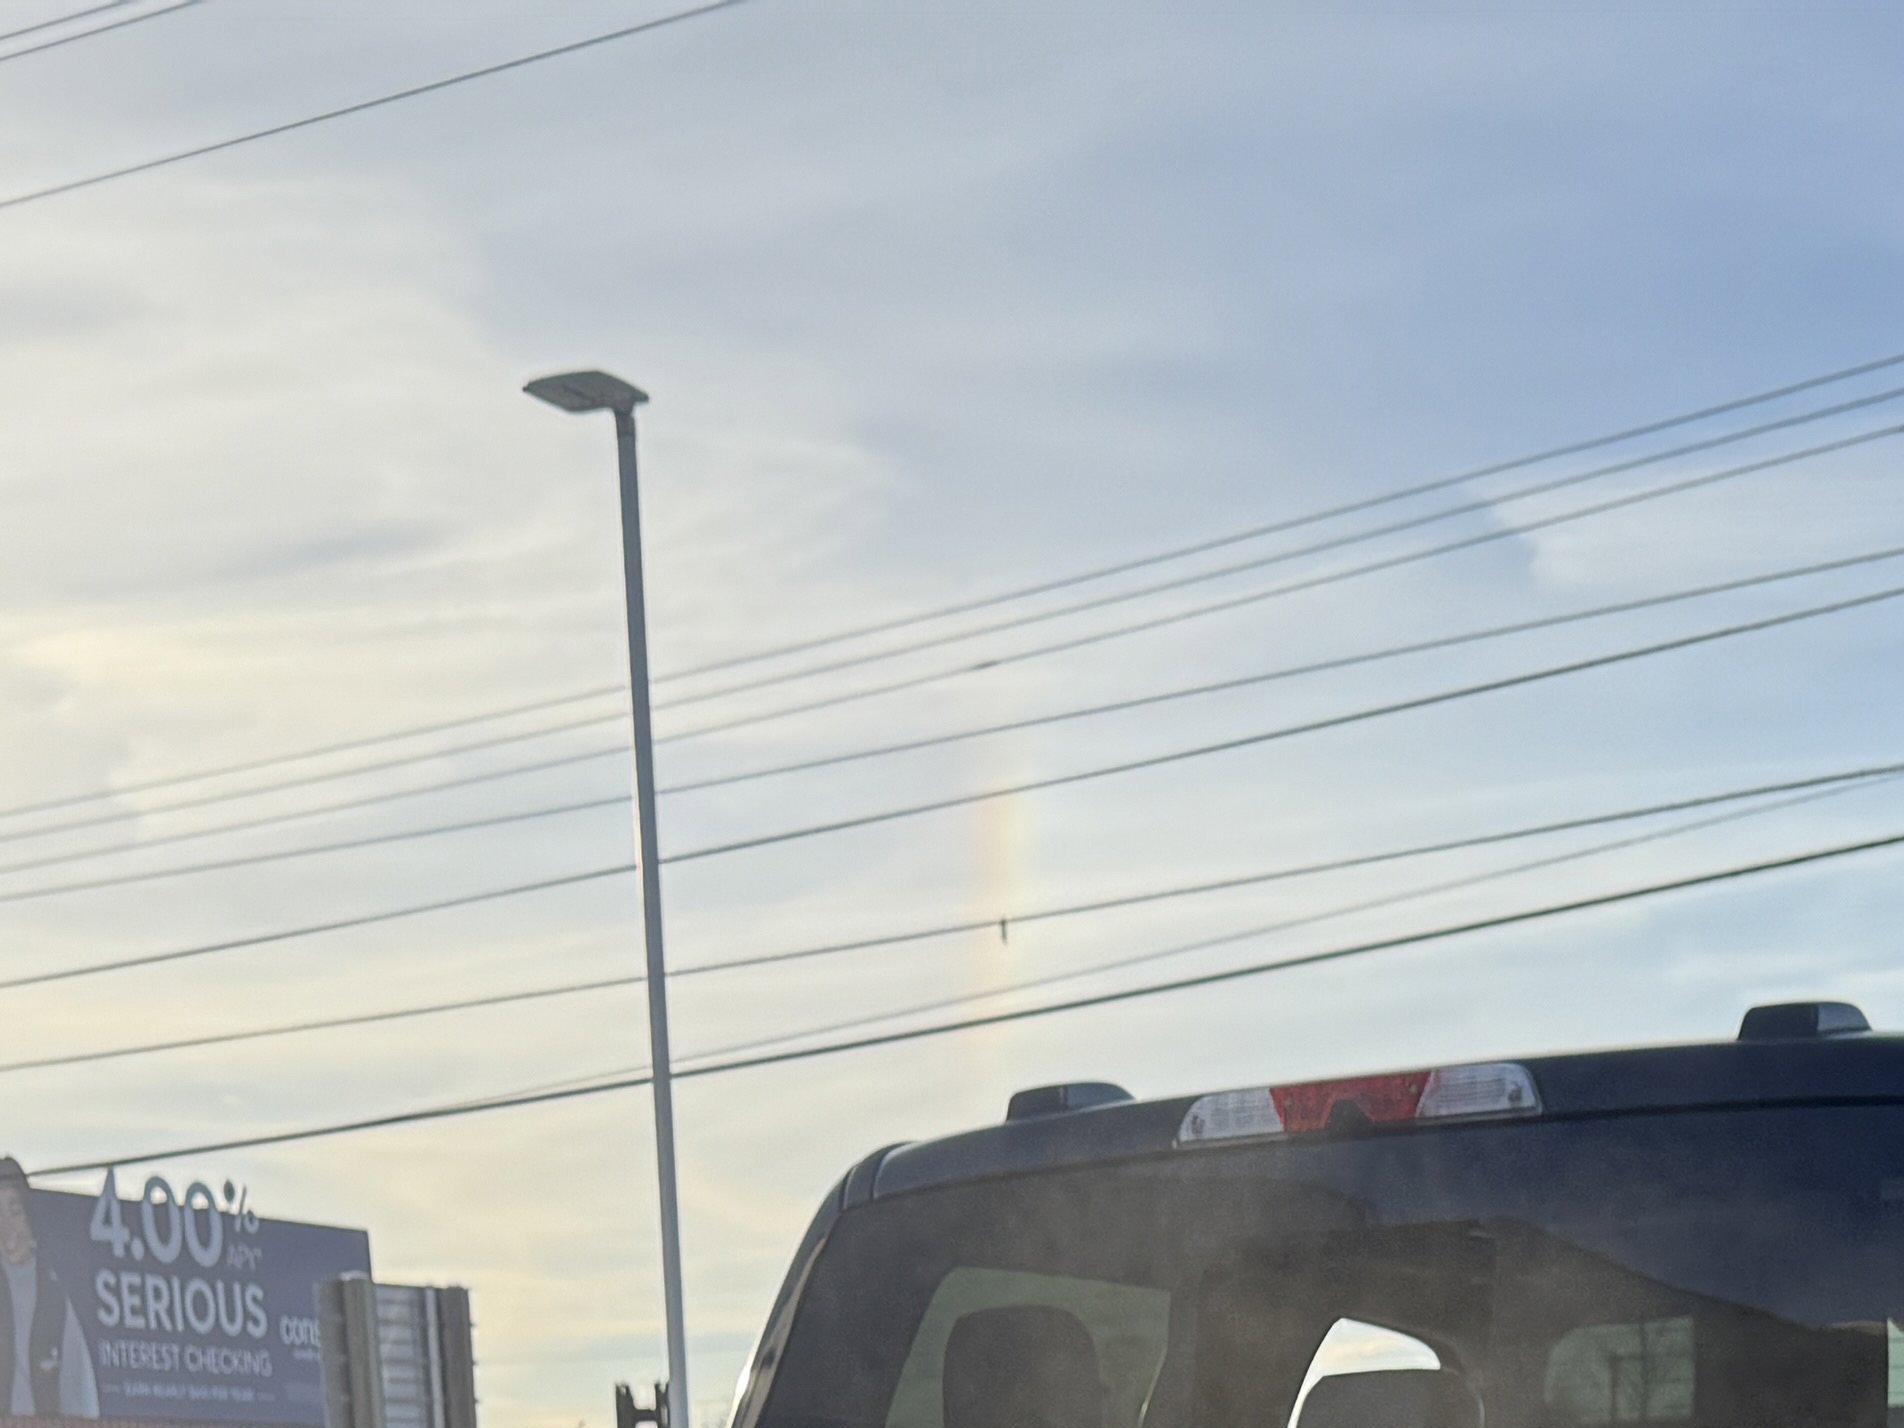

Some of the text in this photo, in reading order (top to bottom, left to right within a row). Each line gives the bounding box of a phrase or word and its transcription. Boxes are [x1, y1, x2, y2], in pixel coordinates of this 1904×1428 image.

[96, 1267, 268, 1338] SERIOUS
[100, 1339, 274, 1378] INTEREST CHECKING
